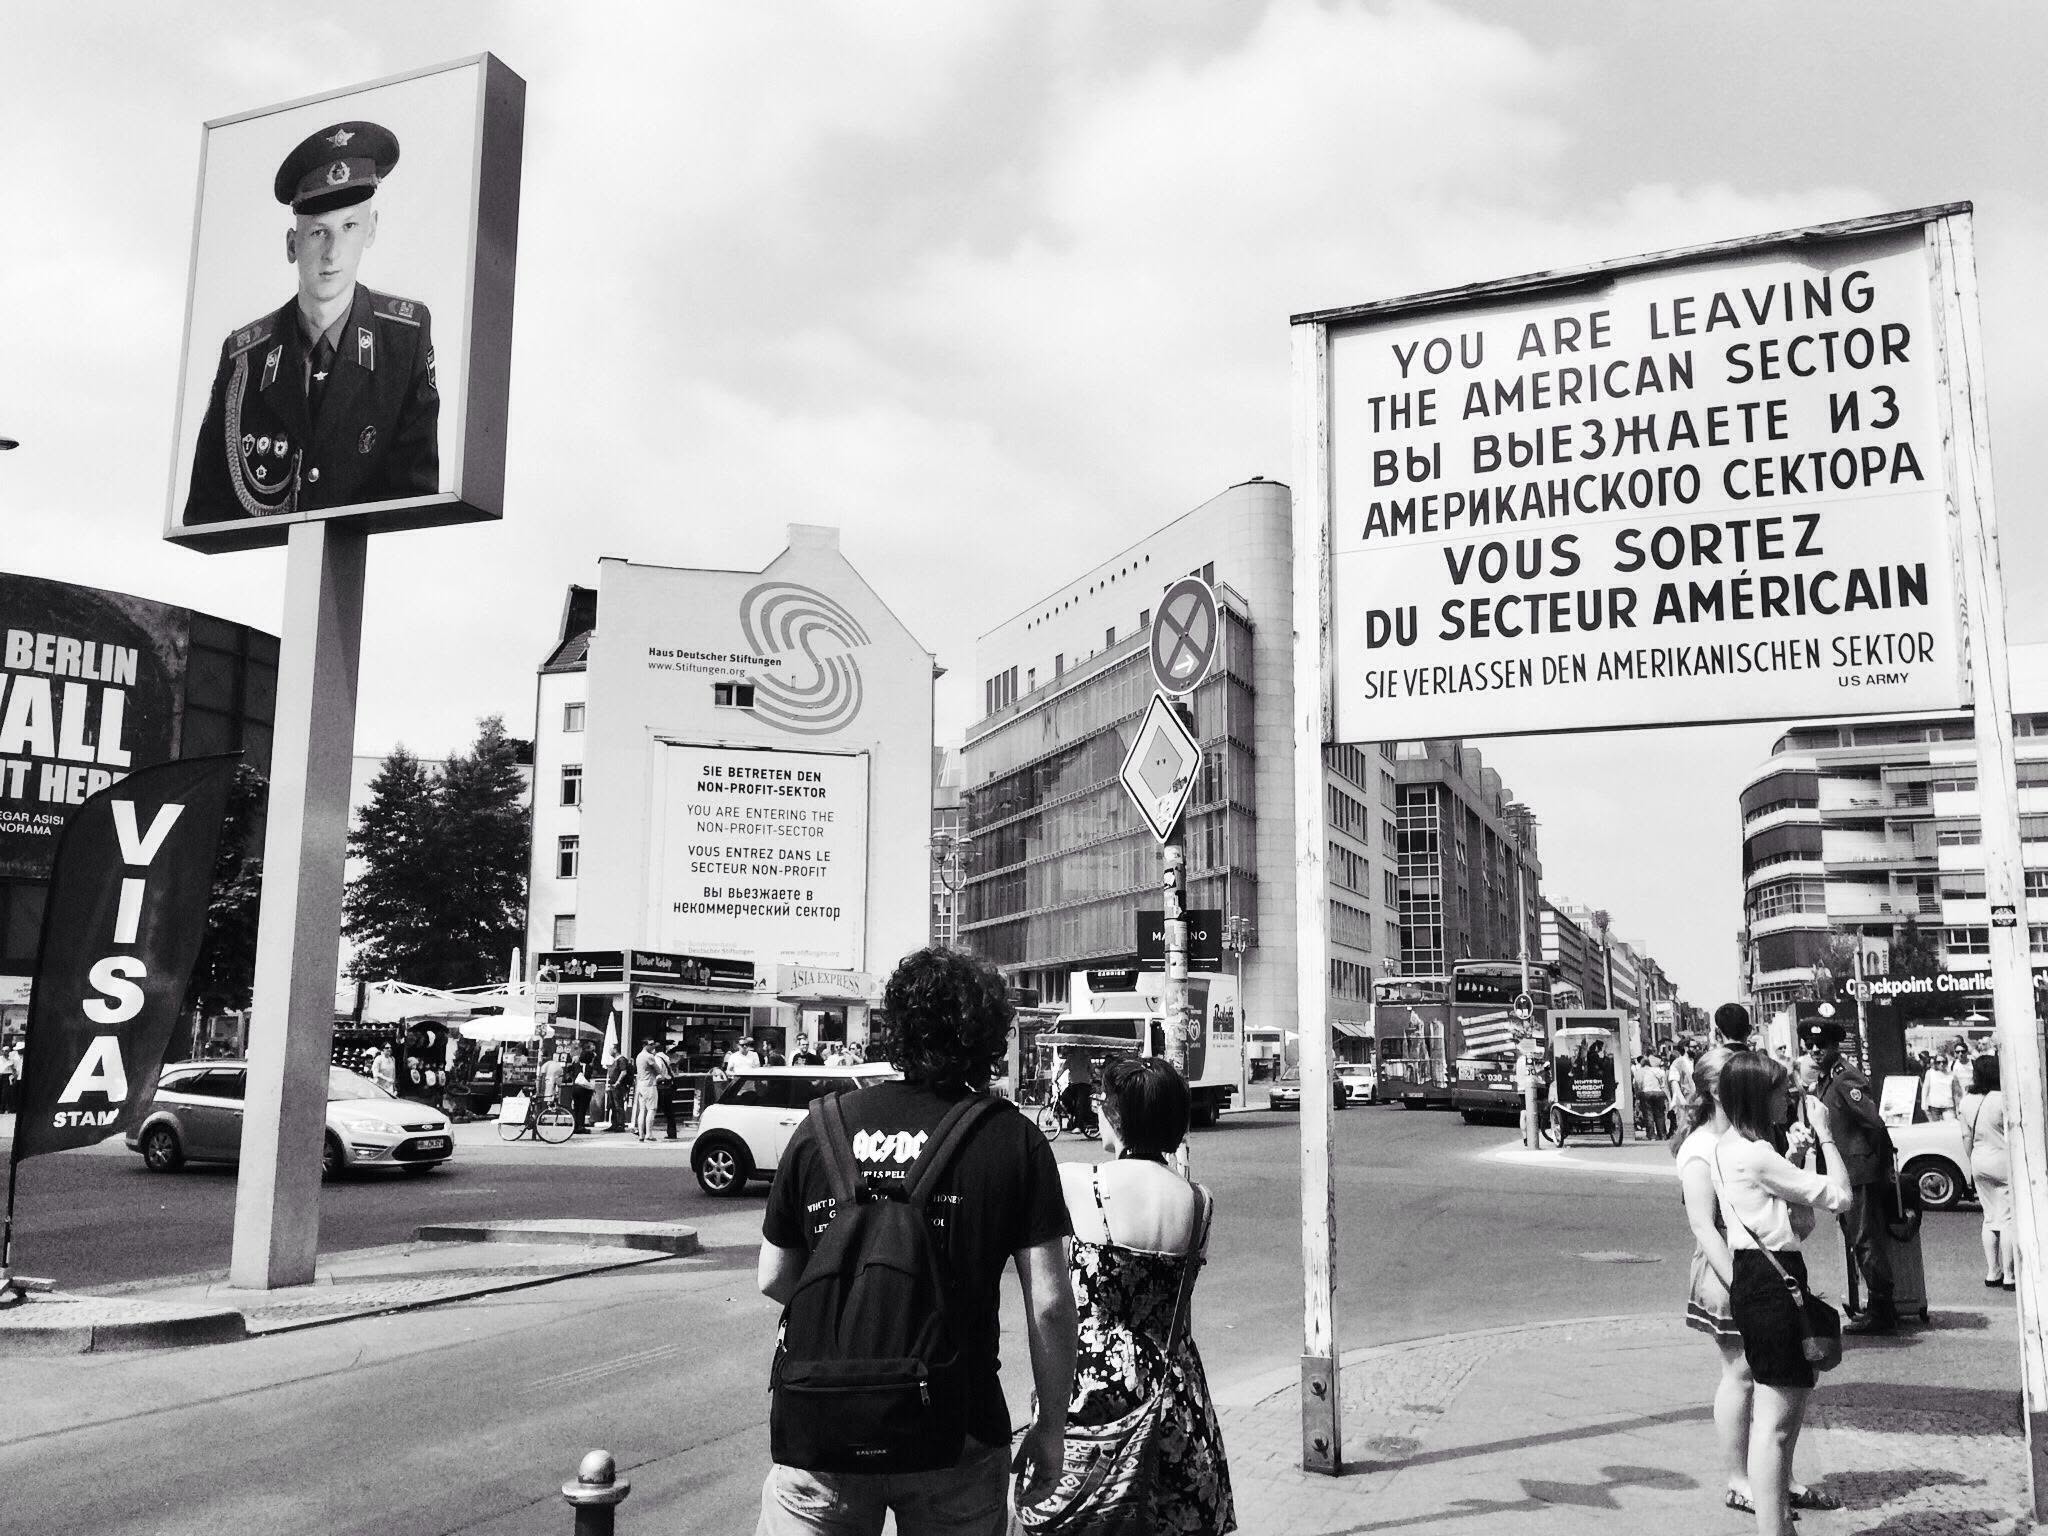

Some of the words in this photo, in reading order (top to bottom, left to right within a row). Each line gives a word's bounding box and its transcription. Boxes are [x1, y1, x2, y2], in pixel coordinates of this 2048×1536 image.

[1392, 330, 1482, 378] YOU
[1518, 310, 1611, 361] ARE
[1651, 271, 1875, 340] LEAVING
[1368, 389, 1436, 433] THE
[1463, 350, 1694, 420] AMERICAN
[1725, 323, 1910, 384] SECTOR
[1830, 386, 1900, 433] ИЗ
[1362, 464, 1700, 540] АМЕРИКАНСКОГО
[1724, 442, 1924, 500] СЕКТОРА
[1443, 534, 1581, 585] VOUS
[1614, 513, 1823, 570] SORTEZ
[1366, 606, 1417, 648] DU
[1439, 587, 1636, 641] SECTEUR
[1653, 562, 1927, 624] AMÉRICAIN
[5, 629, 138, 686] BERLIN
[649, 647, 675, 658] Haus
[676, 649, 728, 662] Deutscher
[730, 653, 782, 667] Stiftungen
[1365, 670, 1398, 699] SIE
[1404, 659, 1532, 696] VERLASSEN
[1543, 653, 1586, 686] DEN
[1596, 638, 1819, 681] AMERIKANISCHEN
[1832, 632, 1933, 667] SEKTOR
[648, 662, 746, 678] www.Stiftungen.org
[1839, 675, 1861, 687] US
[1866, 672, 1909, 686] ARMY
[703, 765, 722, 777] SIE
[728, 767, 792, 781] BETRETEN
[797, 770, 821, 782] DEN
[697, 781, 826, 798] NON-PROFIT-SEKTOR
[33, 814, 64, 825] ASISI
[688, 804, 710, 817] YOU
[716, 806, 739, 818] ARE
[746, 808, 806, 821] ENTERING
[812, 811, 834, 822] THE
[697, 821, 824, 837] NON-PROFIT-SECTOR
[688, 845, 720, 857] VOUS
[726, 847, 773, 860] ENTREZ
[779, 849, 811, 861] DANS
[817, 851, 831, 862] LE
[691, 862, 747, 875] SECTEUR
[752, 864, 827, 878] NON-PROFIT
[796, 905, 841, 922] сектор
[57, 799, 186, 1104] VISA
[791, 969, 814, 990] ASIA
[817, 971, 860, 994] EXPRESS
